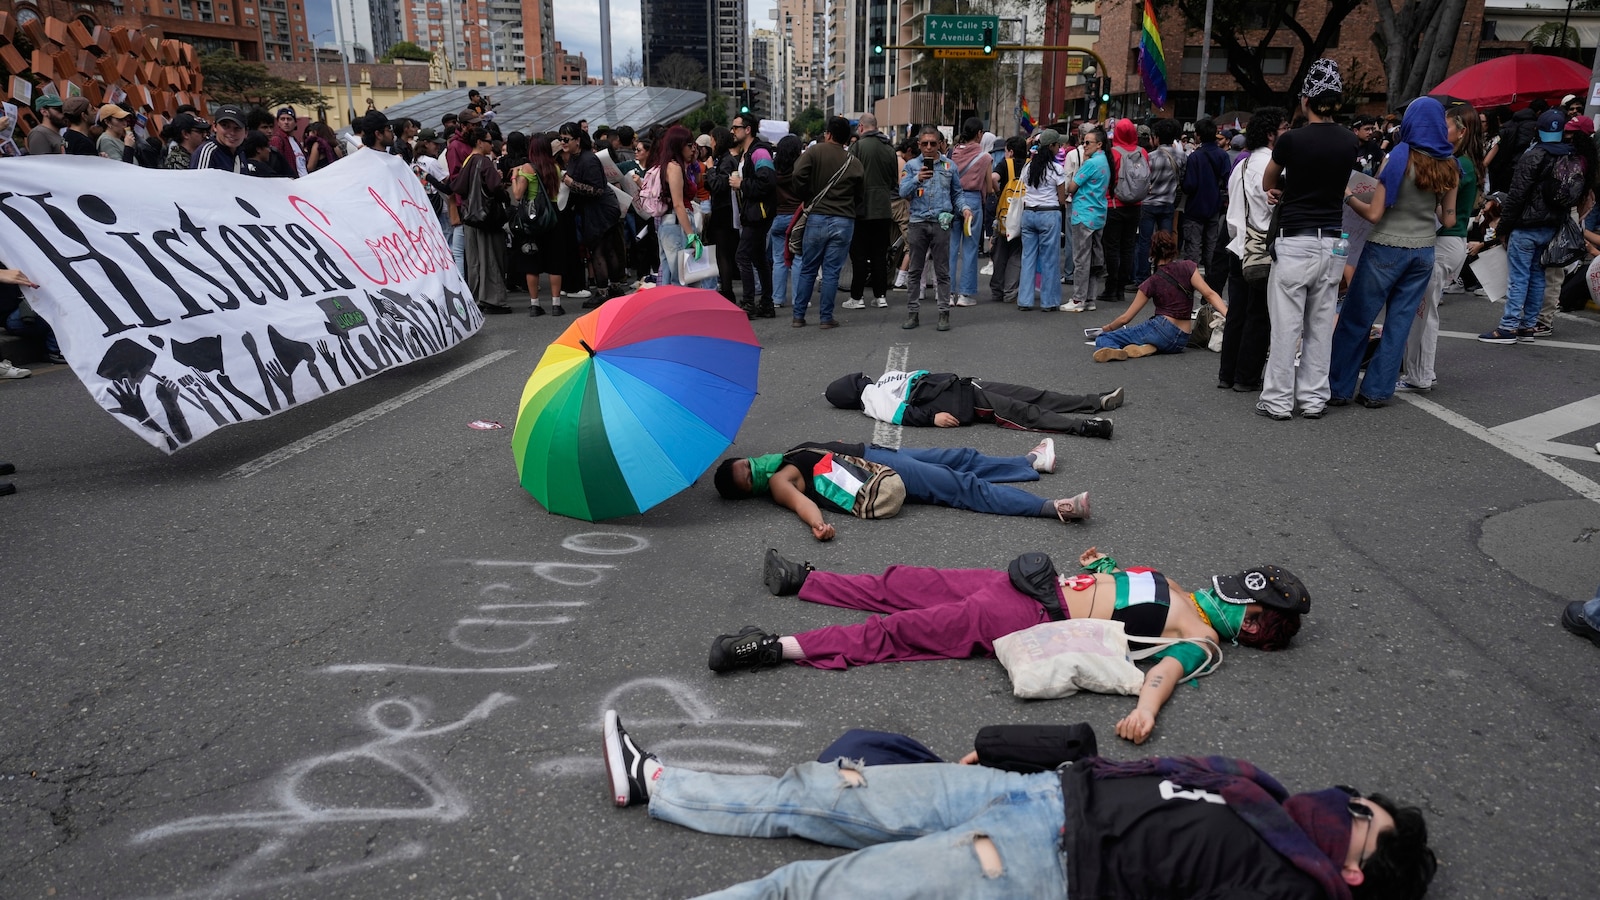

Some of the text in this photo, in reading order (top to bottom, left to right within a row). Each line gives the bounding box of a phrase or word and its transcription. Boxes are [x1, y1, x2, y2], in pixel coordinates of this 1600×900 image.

[941, 20, 994, 29] Av Calle 53
[940, 33, 975, 41] Avenida
[0, 191, 356, 337] Historia
[333, 298, 343, 310] A
